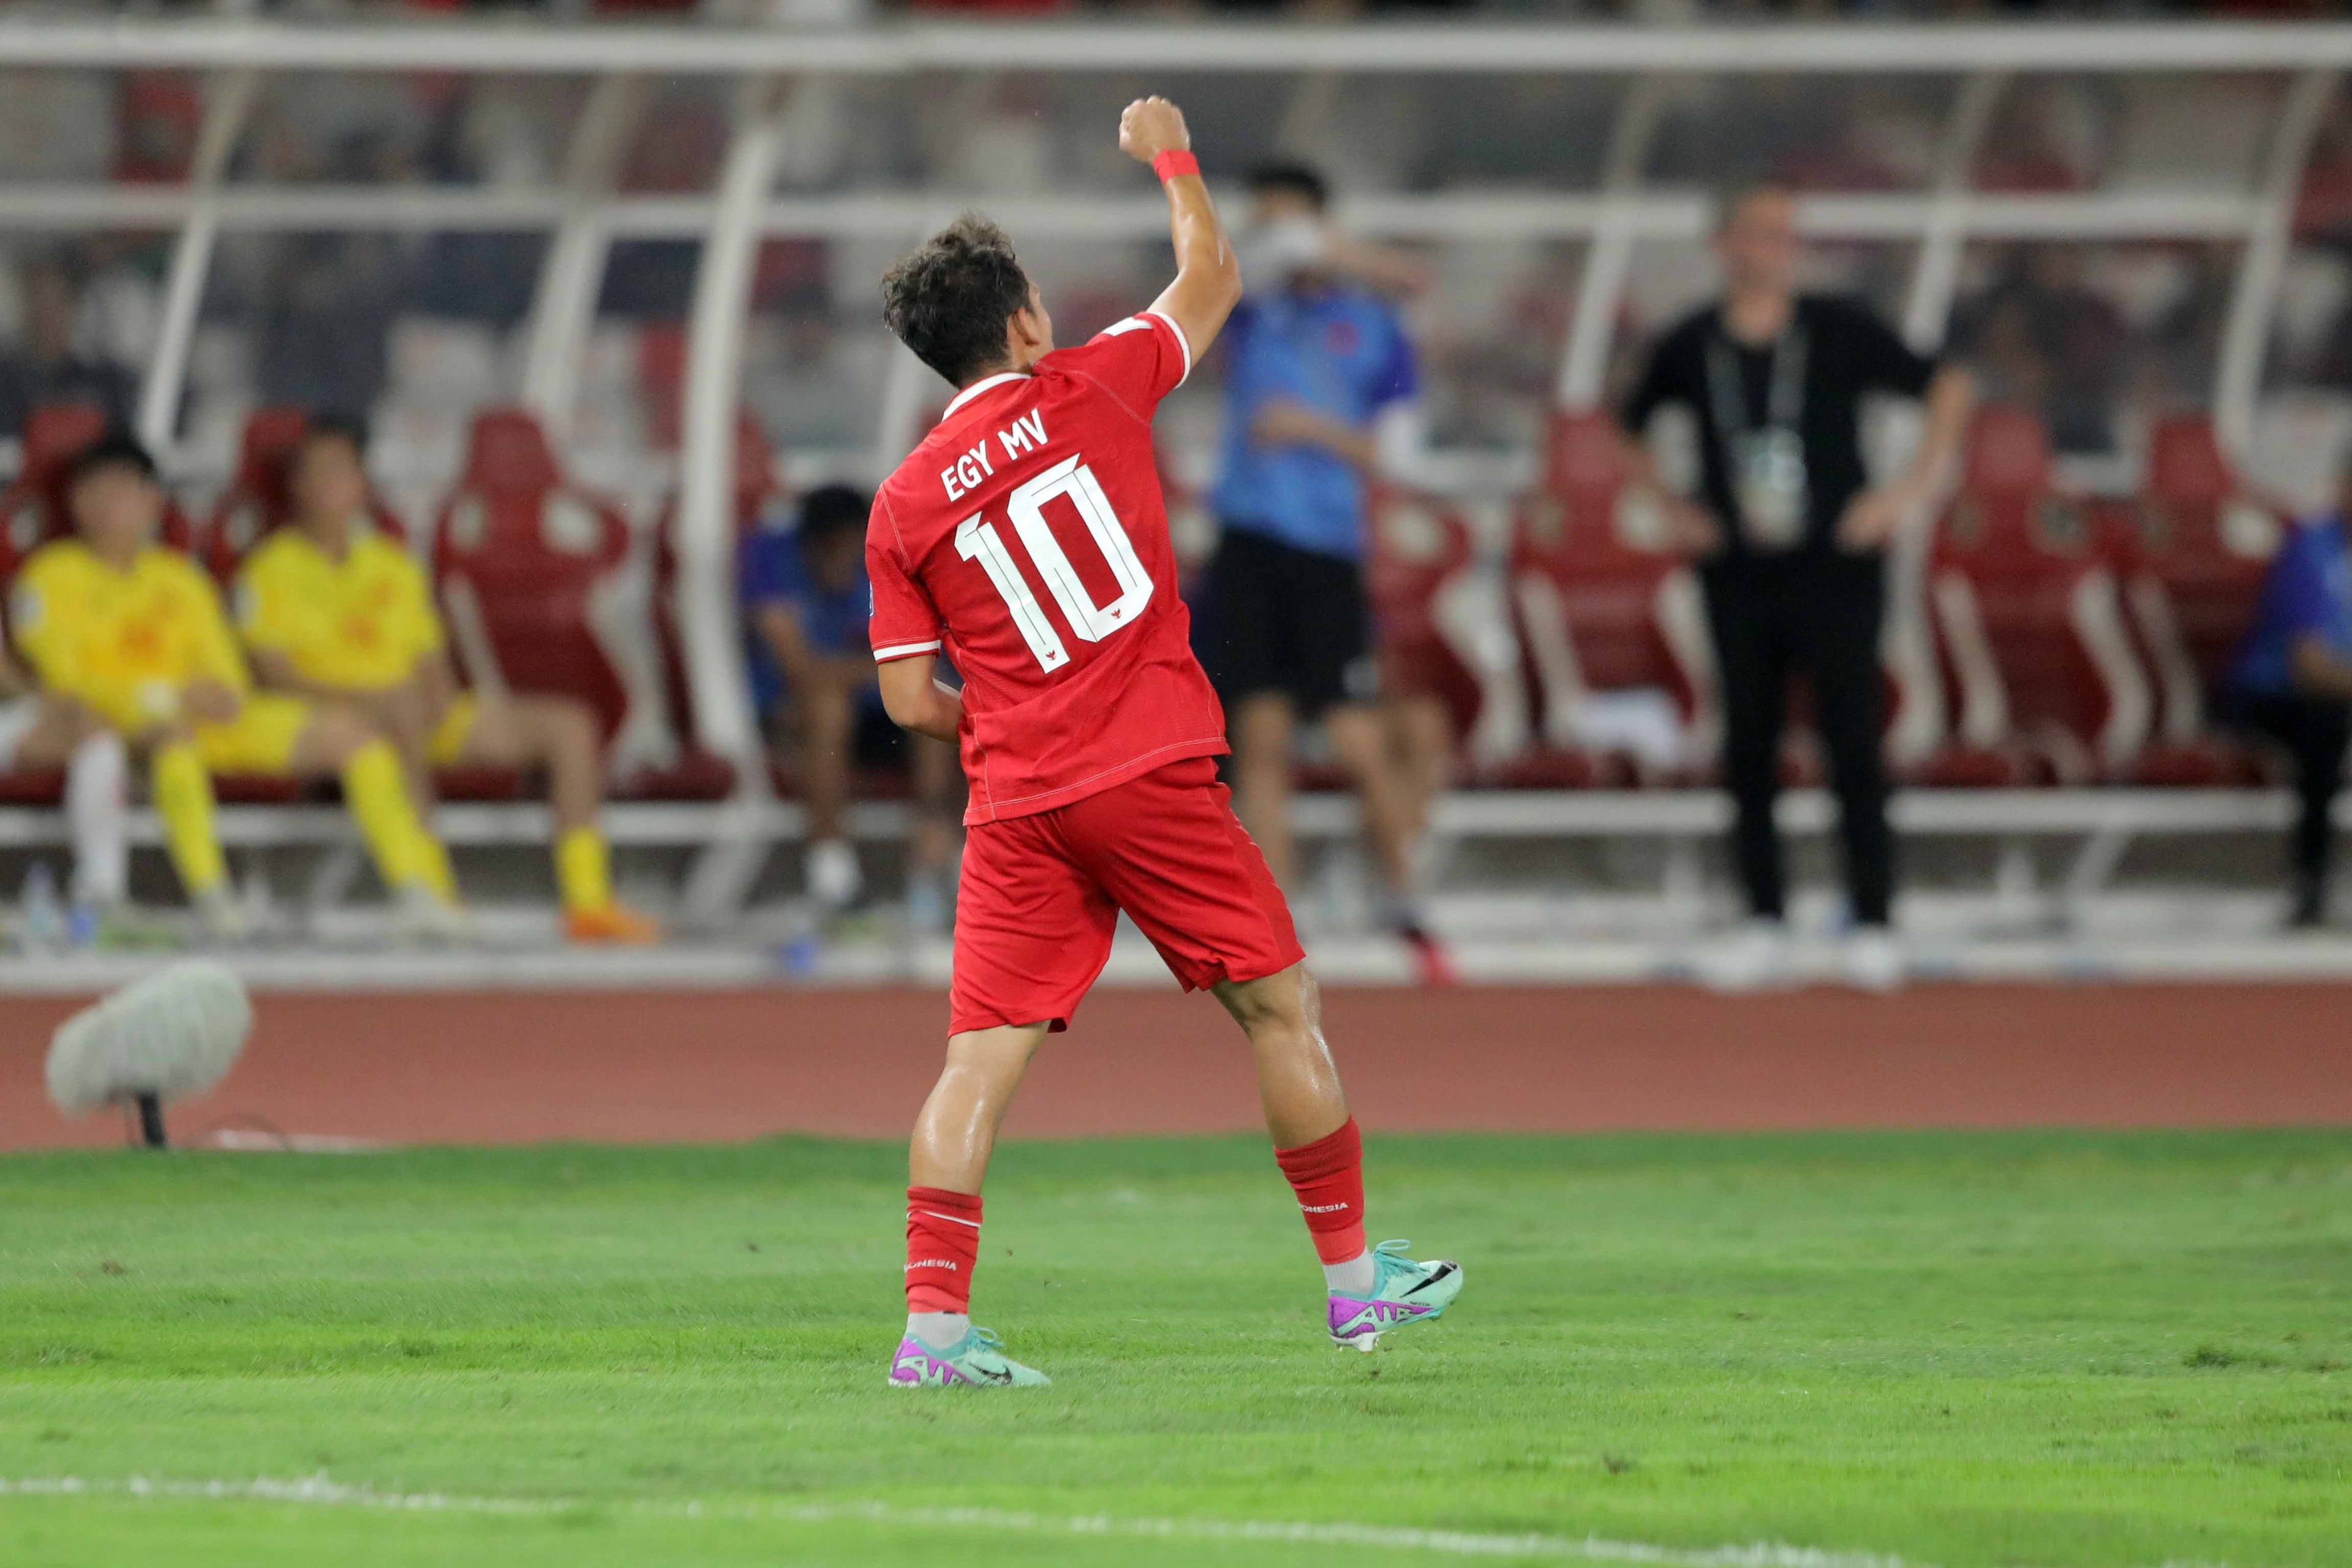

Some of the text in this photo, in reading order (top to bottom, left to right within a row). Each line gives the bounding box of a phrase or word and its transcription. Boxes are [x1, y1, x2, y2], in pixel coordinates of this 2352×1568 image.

[940, 407, 1048, 502] EGY MV
[954, 453, 1155, 674] 10
